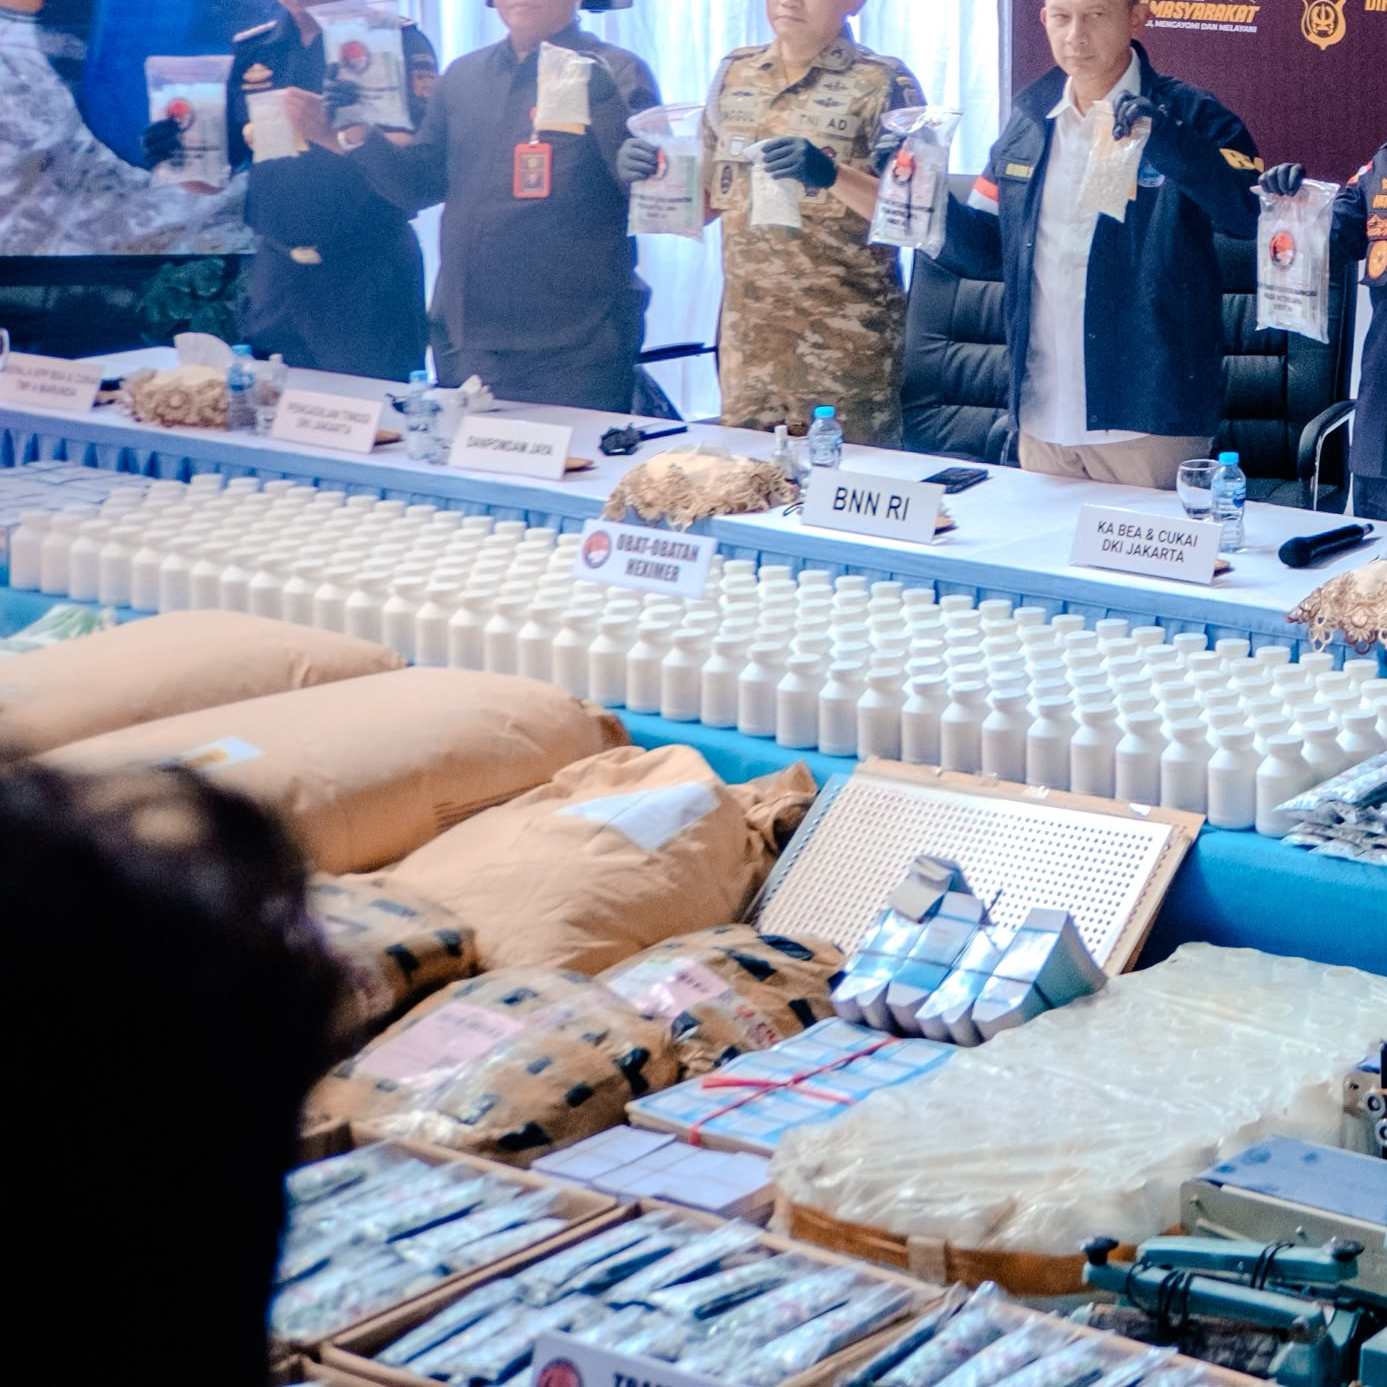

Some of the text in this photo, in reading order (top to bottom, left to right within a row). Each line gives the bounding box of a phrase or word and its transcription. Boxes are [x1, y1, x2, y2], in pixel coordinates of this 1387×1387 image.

[828, 119, 847, 130] AD
[833, 487, 910, 521] BNN RI
[1097, 521, 1198, 547] KA BEA & CUKAI
[616, 533, 699, 562] OBAT-OBATAN
[1102, 538, 1184, 562] DKI JAKARTA
